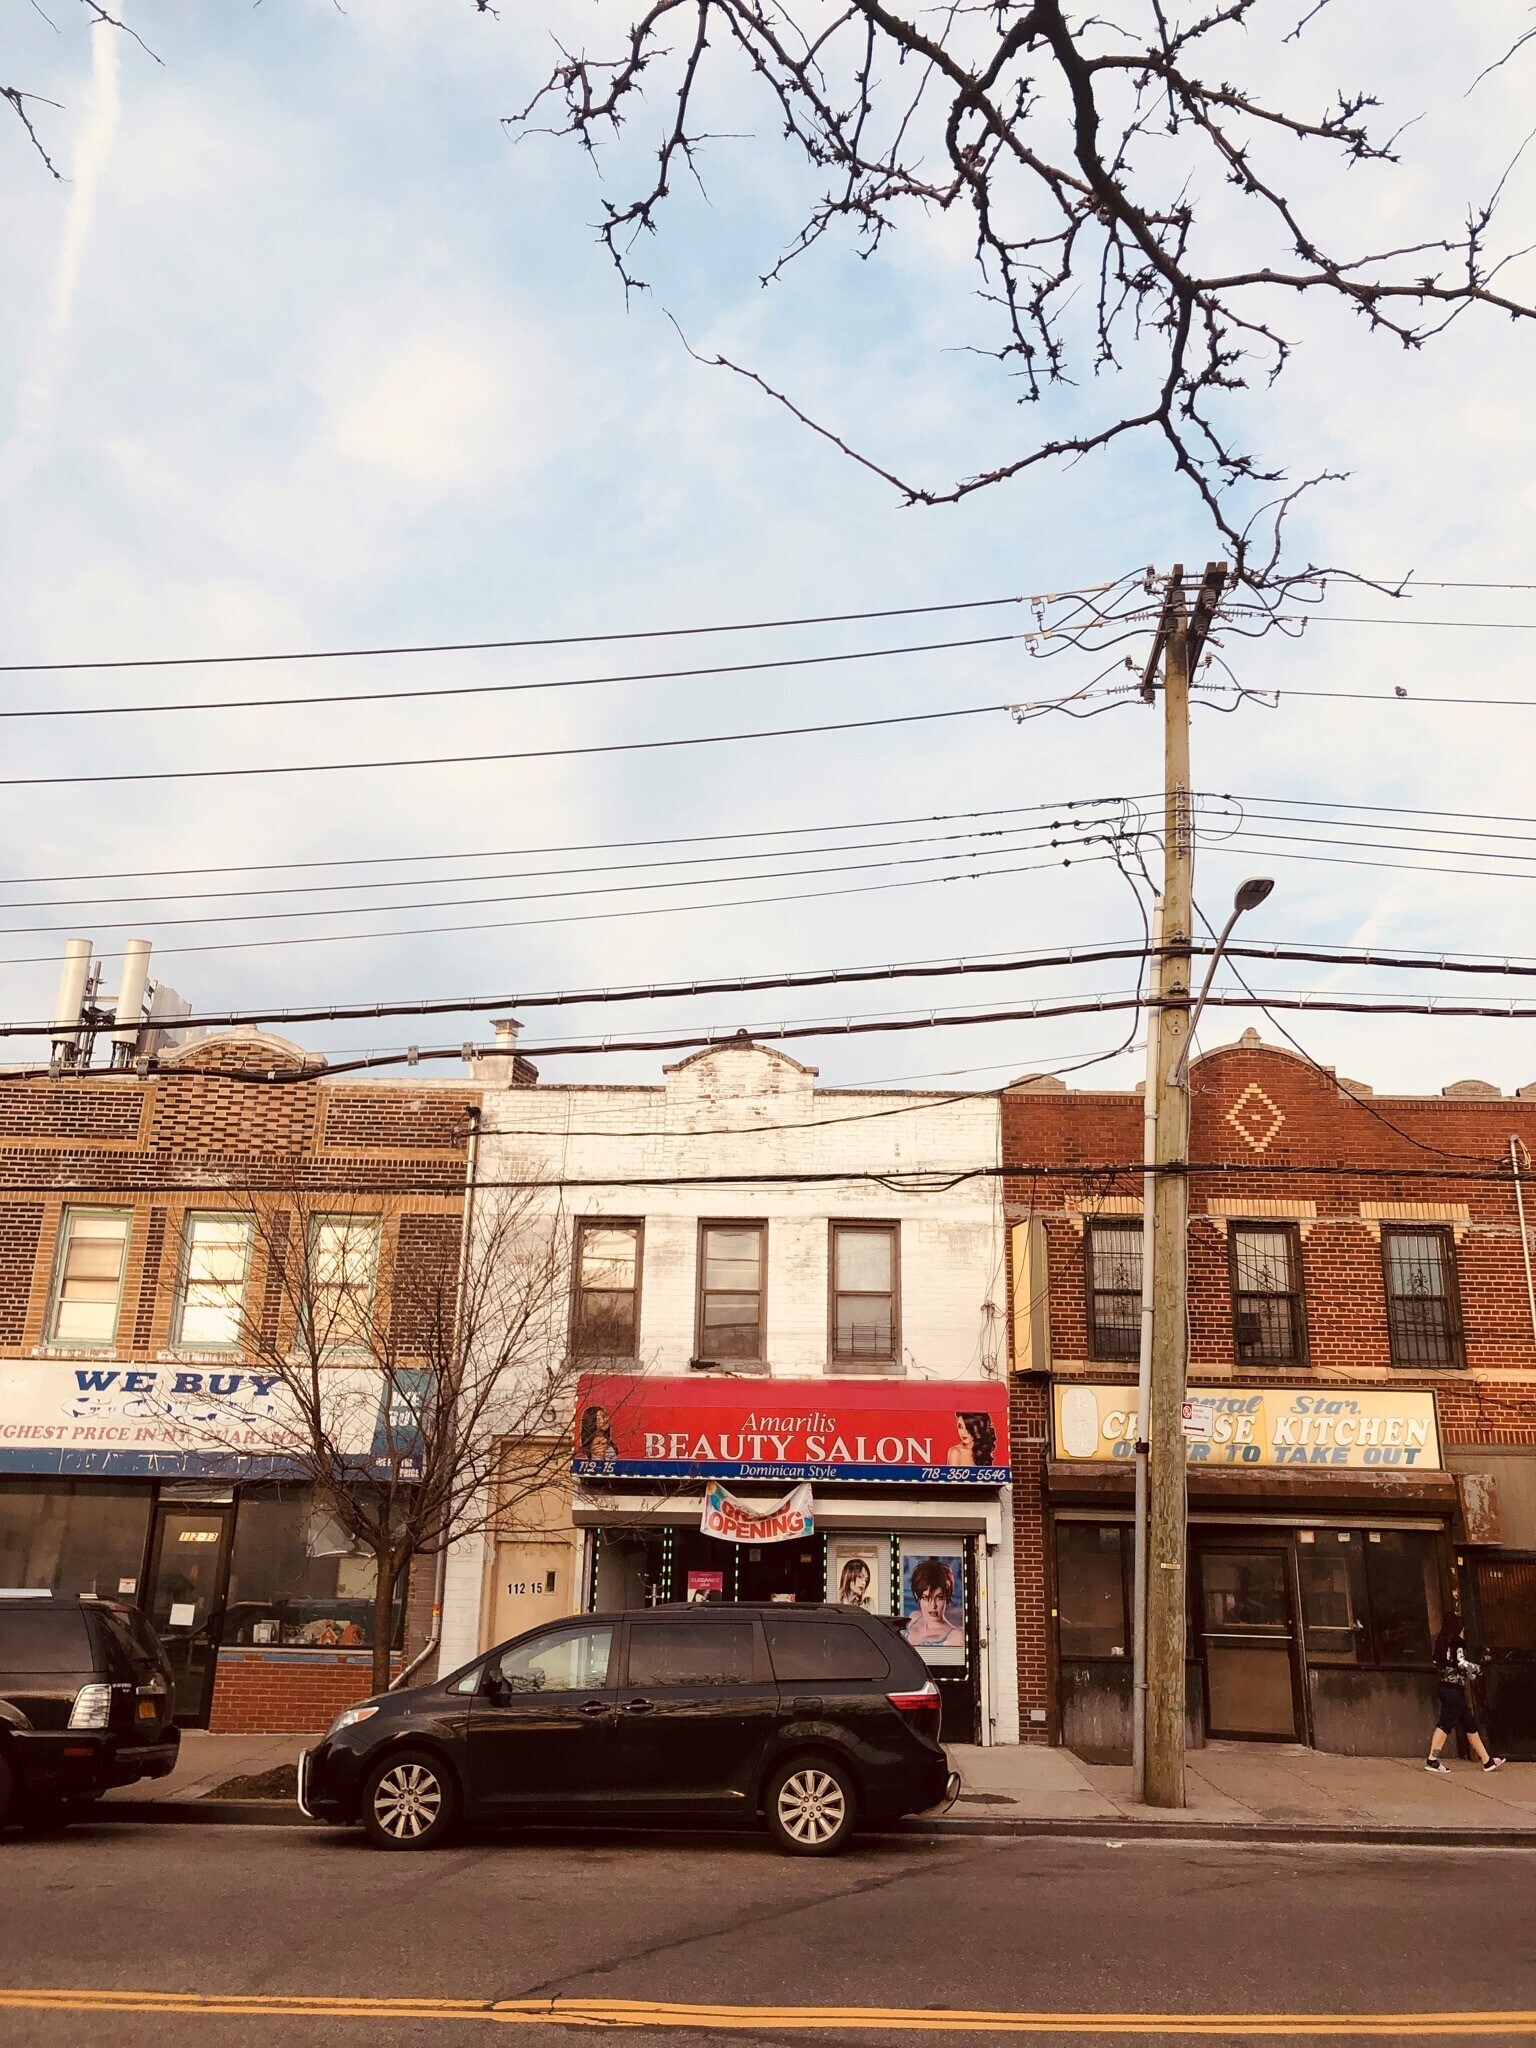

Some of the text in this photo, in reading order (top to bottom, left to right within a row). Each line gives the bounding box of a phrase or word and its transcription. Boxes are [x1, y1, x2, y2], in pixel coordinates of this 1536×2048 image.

[75, 1371, 283, 1396] WE BUY
[740, 1412, 836, 1432] Amarilis
[1272, 1416, 1431, 1446] KITCHEN
[72, 1426, 130, 1440] PRICE
[134, 1427, 158, 1441] IN
[643, 1433, 932, 1463] BEAUTY SALON
[1225, 1445, 1261, 1462] TO
[1274, 1447, 1350, 1464] TAKE
[1363, 1448, 1421, 1465] OUT
[578, 1461, 616, 1473] 112-15
[739, 1464, 837, 1479] Dominican Style
[921, 1467, 1006, 1480] 718-350-5546
[708, 1511, 804, 1538] OPENING
[507, 1582, 542, 1594] 112 15
